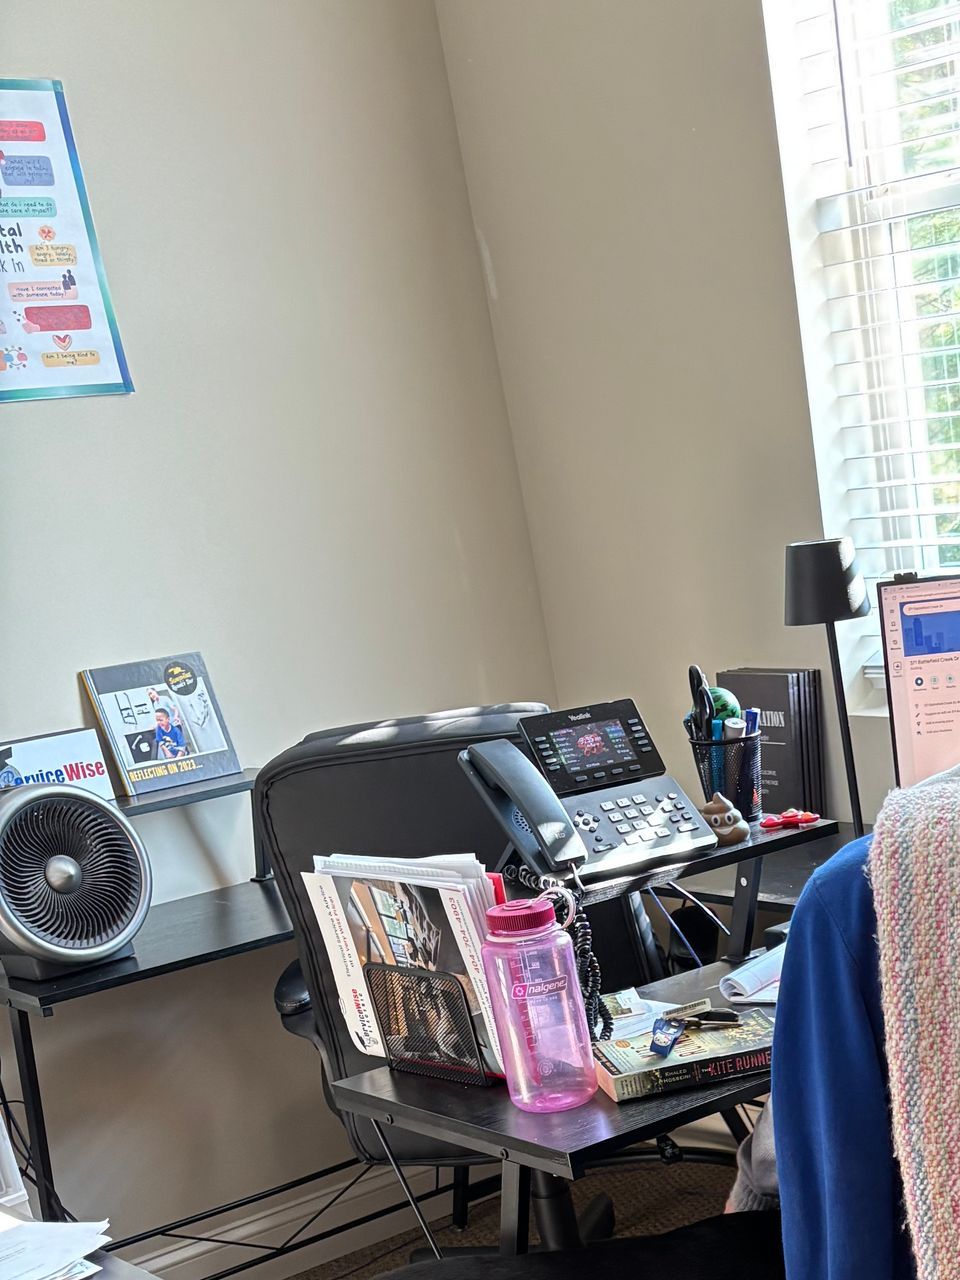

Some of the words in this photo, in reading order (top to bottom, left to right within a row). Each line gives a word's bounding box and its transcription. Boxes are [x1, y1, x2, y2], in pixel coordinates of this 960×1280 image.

[129, 766, 168, 783] REFLECTING
[167, 763, 179, 775] ON
[528, 980, 565, 994] nalgene
[709, 1060, 734, 1076] KITE
[735, 1050, 772, 1071] RUNNE
